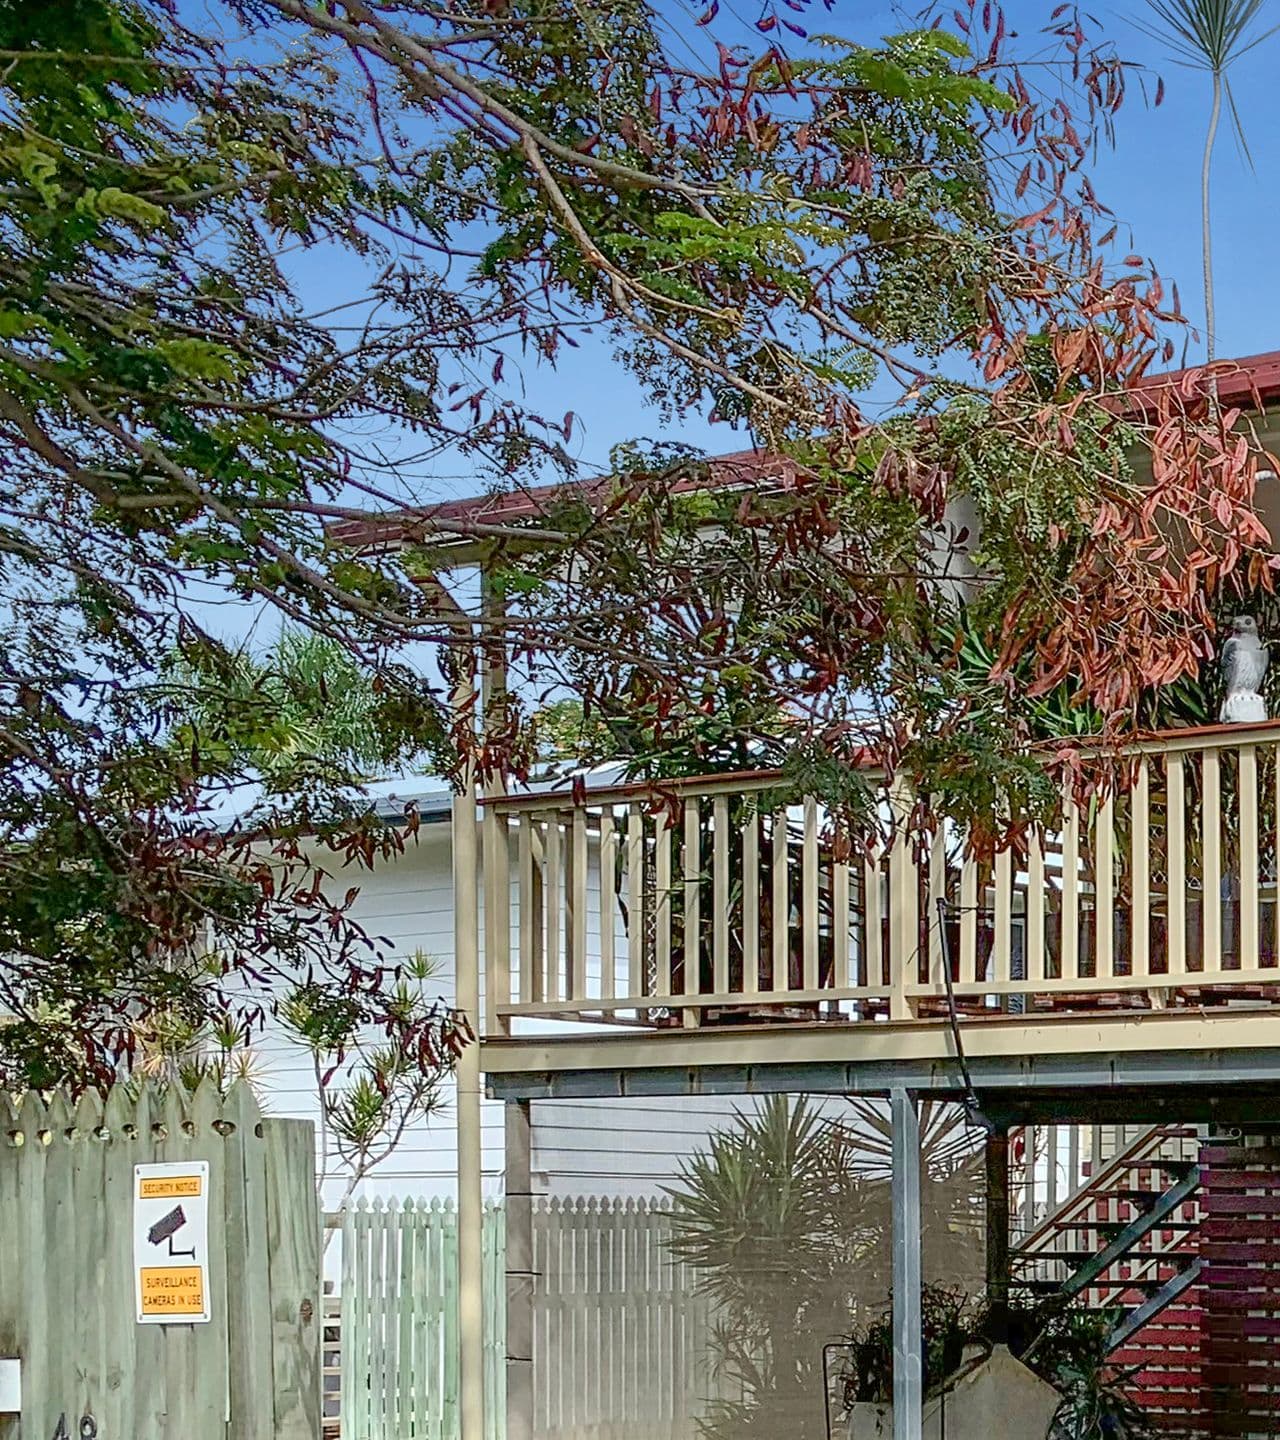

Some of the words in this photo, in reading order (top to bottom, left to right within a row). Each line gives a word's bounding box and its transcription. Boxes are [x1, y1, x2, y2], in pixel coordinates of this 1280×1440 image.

[143, 1183, 174, 1194] SECURITY
[175, 1181, 198, 1192] NOTICE
[146, 1276, 197, 1289] SURVEILLANCE
[143, 1295, 176, 1306] CAMERAS
[187, 1294, 201, 1305] USE
